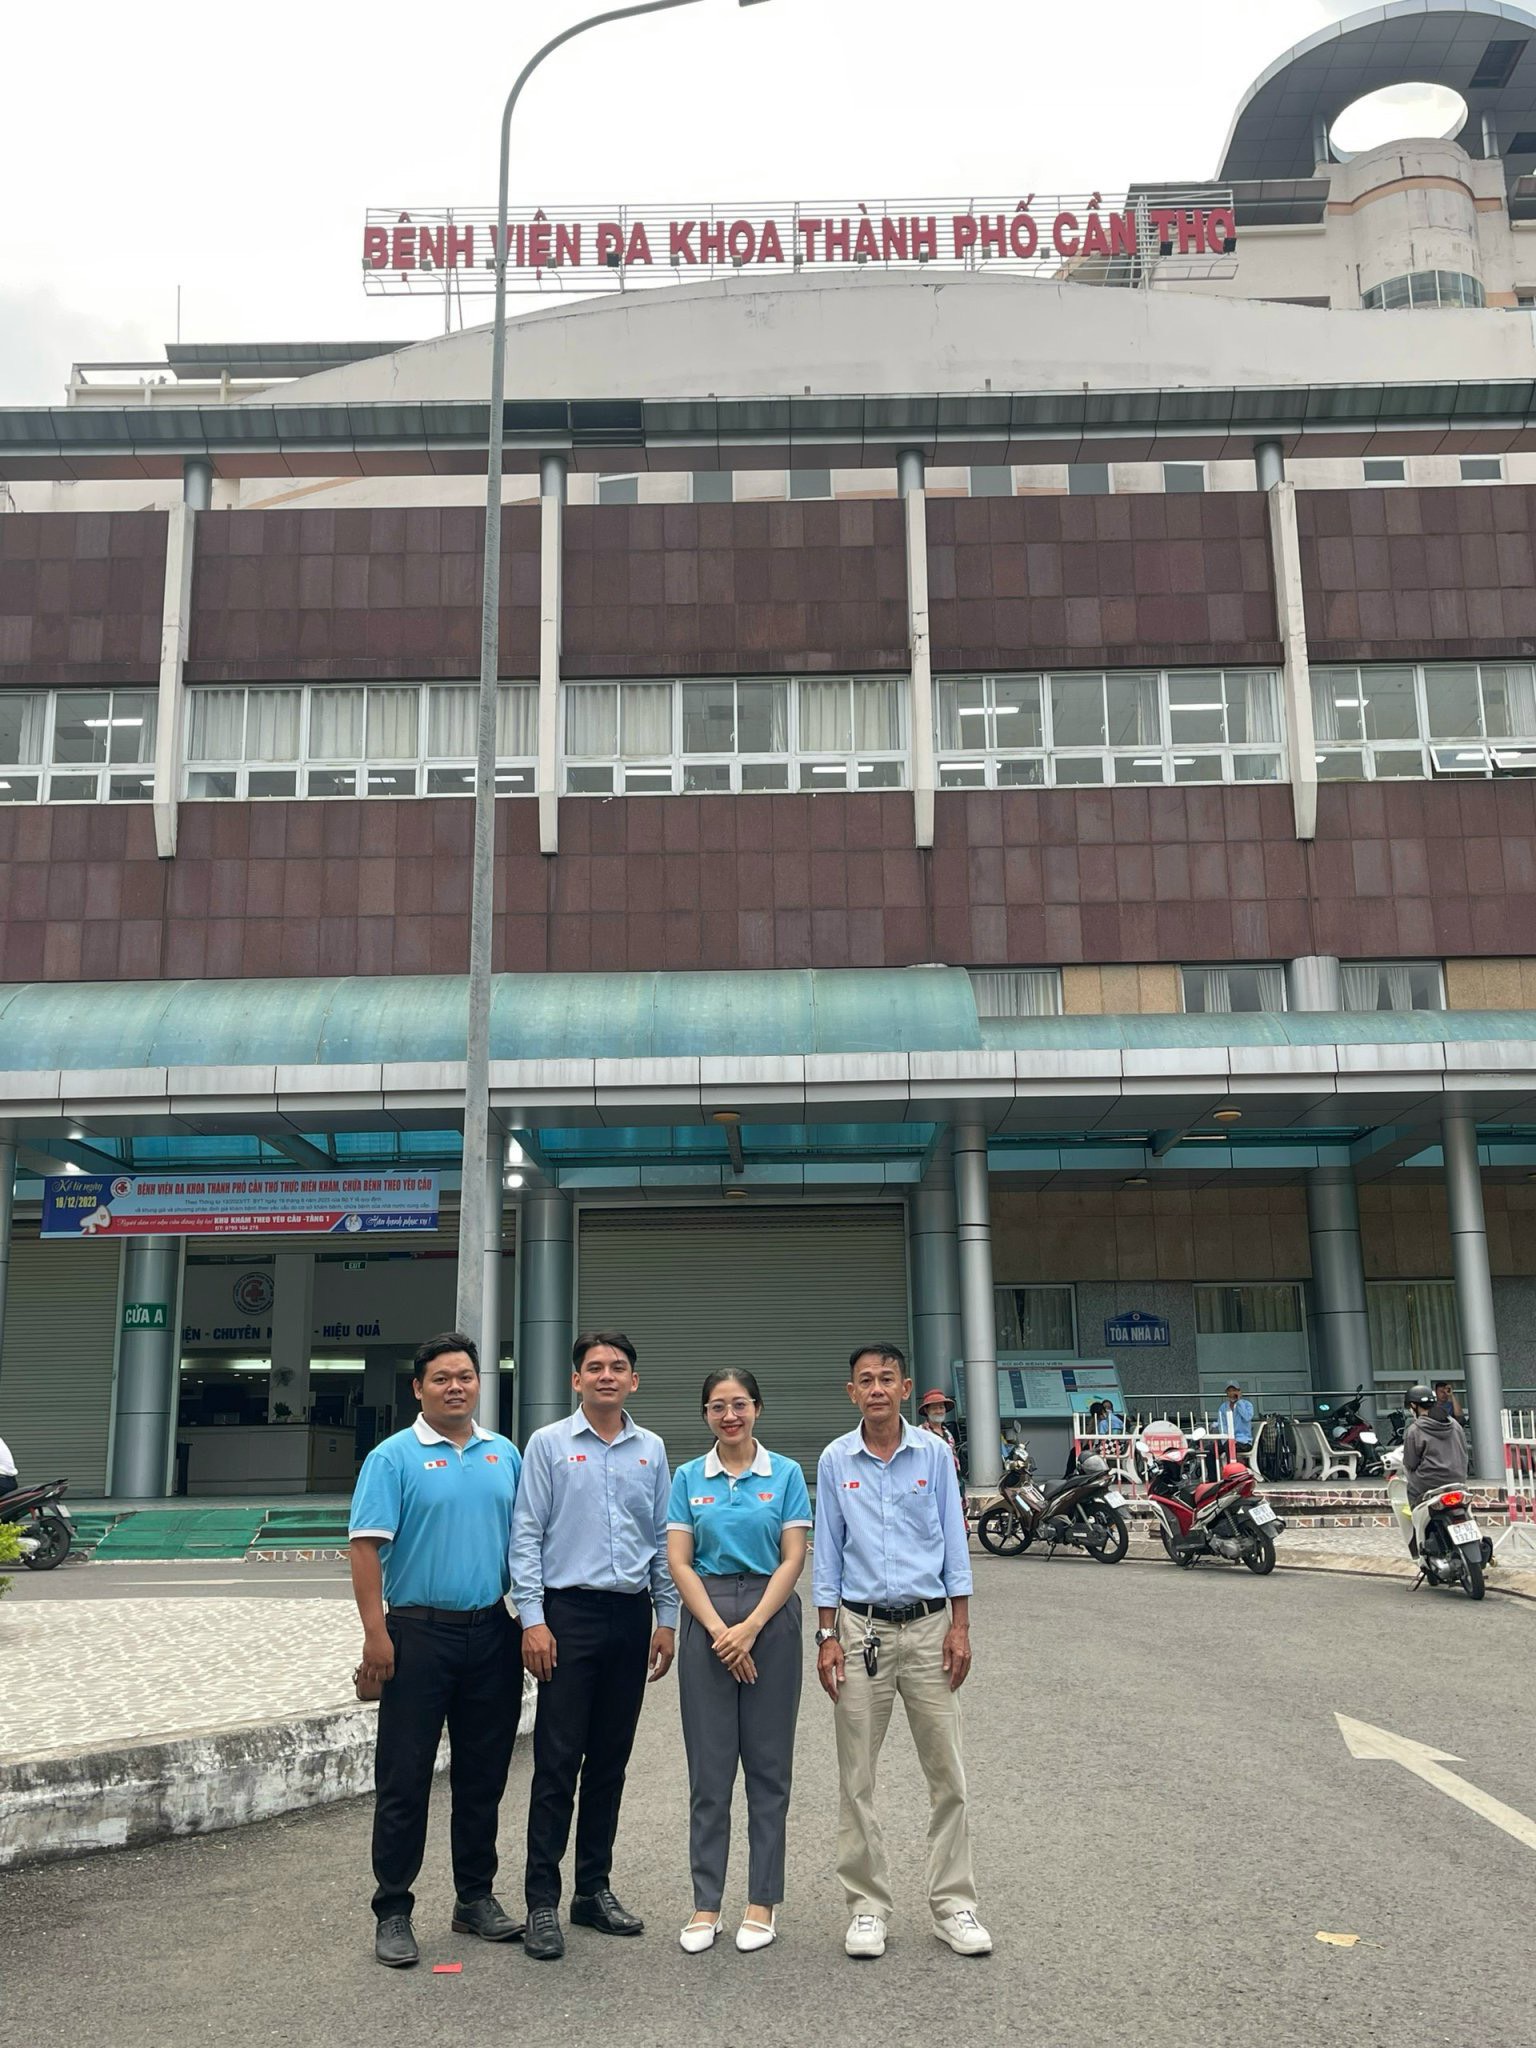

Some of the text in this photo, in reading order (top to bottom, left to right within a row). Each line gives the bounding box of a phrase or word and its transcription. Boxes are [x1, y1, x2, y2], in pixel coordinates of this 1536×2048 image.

[363, 211, 474, 281] BỆNH
[596, 222, 654, 268] ĐA
[670, 219, 785, 267] KHOA
[799, 203, 937, 263] THÀNH
[953, 193, 1039, 260] PHỐ
[1053, 192, 1137, 257] CẦN
[186, 1183, 205, 1194] KHOA
[384, 1179, 401, 1192] THEO
[403, 1177, 416, 1191] YÊU
[125, 1304, 164, 1324] CỬA A
[213, 1324, 260, 1340] CHUYÊN
[323, 1322, 350, 1341] HIỆU
[356, 1319, 381, 1337] QUẢ
[1109, 1324, 1165, 1341] TÒA NHÀ A1
